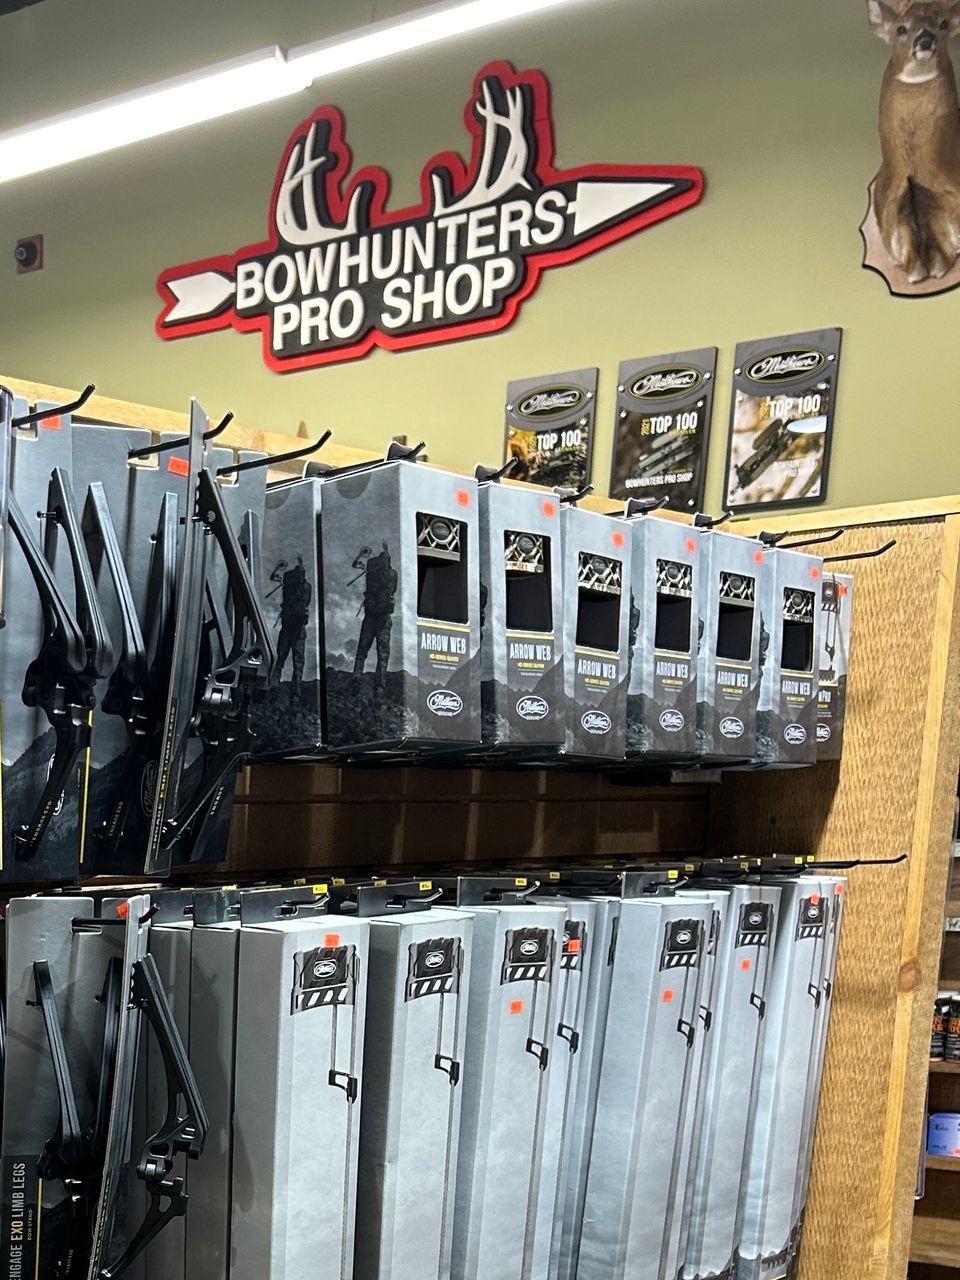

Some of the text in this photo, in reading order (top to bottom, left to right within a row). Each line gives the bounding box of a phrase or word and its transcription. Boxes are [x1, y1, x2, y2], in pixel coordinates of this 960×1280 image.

[236, 190, 565, 310] BOWHUNTERS
[272, 258, 516, 351] PRO SHOP
[751, 352, 820, 379] Mathews
[632, 371, 697, 396] Mathews
[520, 390, 580, 414] Mathews
[769, 394, 821, 418] TOP 100
[650, 415, 672, 434] TOP
[676, 412, 699, 430] 100
[536, 433, 558, 451] TOP
[561, 429, 581, 447] 100
[421, 632, 467, 655] ARROW WEB
[509, 643, 551, 661] ARROW WEB
[577, 659, 616, 679] ARROW WEB
[656, 661, 689, 679] ARROW WEB
[717, 670, 749, 688] ARROW WEB
[782, 679, 811, 696] ARROW WEB
[13, 1163, 26, 1191] LEGS
[11, 1192, 25, 1218] LIMB
[11, 1219, 24, 1241] EXO
